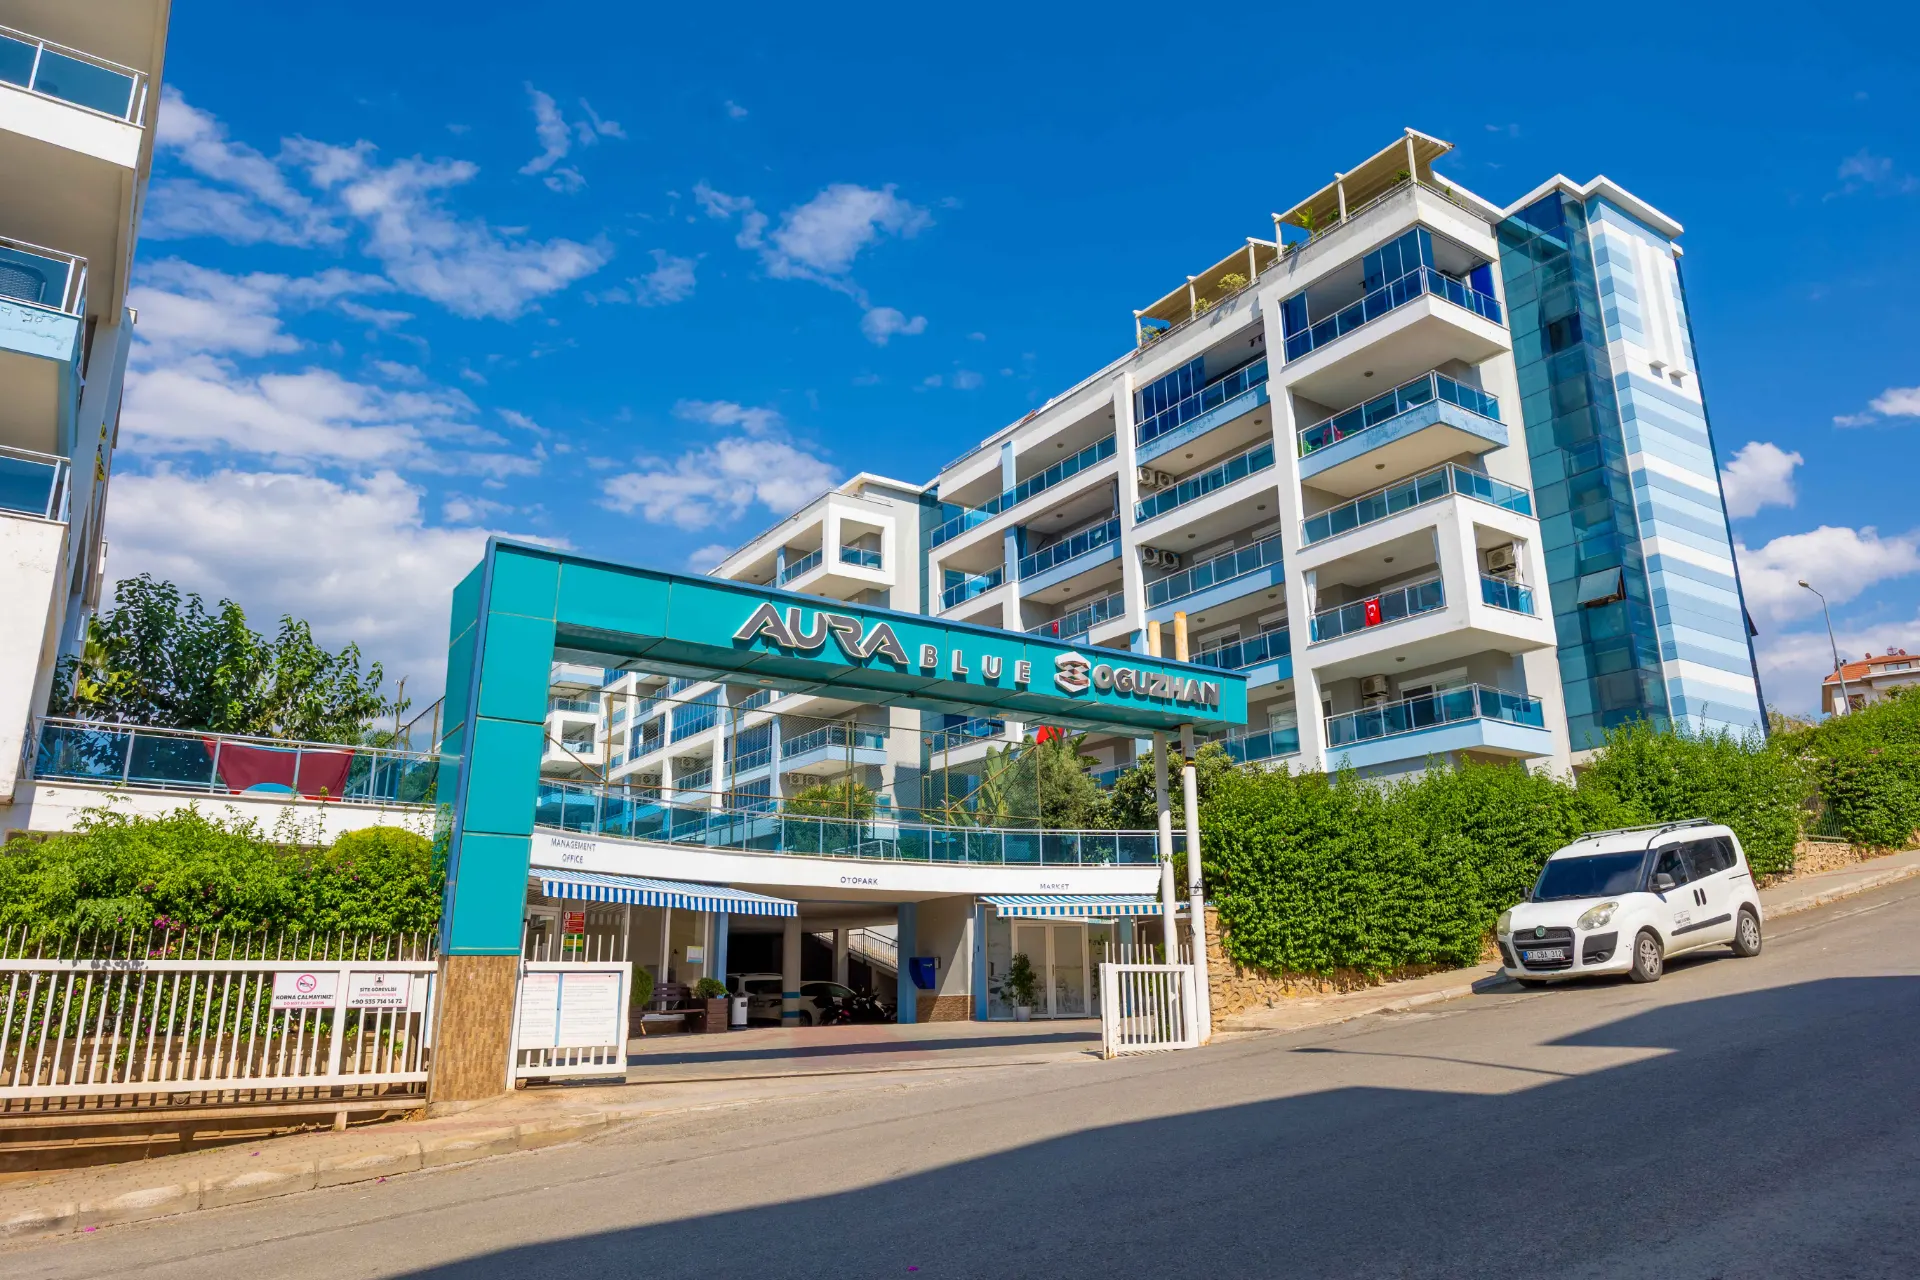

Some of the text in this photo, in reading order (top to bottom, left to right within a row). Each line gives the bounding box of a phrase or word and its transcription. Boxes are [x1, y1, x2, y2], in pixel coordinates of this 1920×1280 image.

[732, 602, 1221, 706] AURA BLUE OGUZHAN
[551, 838, 596, 851] MANAGEMENT
[562, 853, 583, 864] OFFICE
[840, 876, 878, 885] OTOPARK
